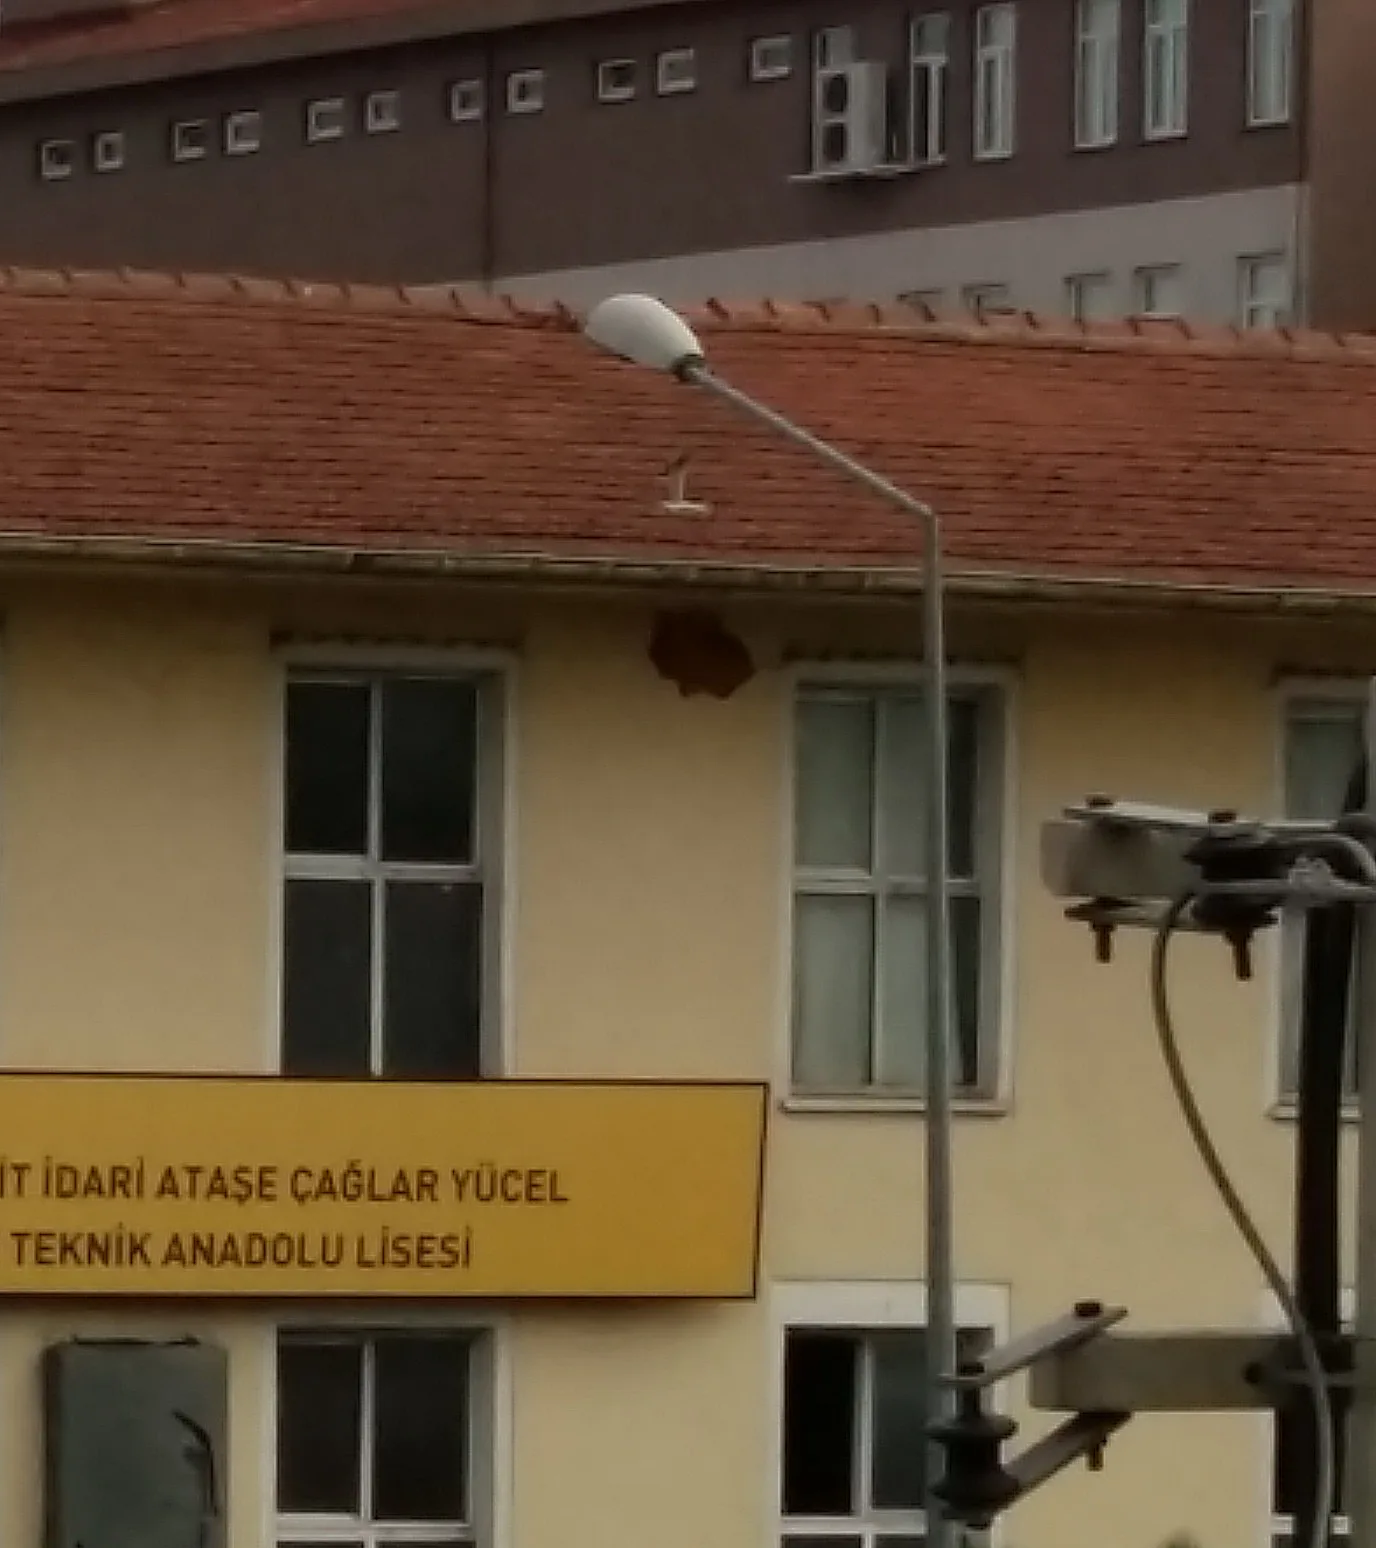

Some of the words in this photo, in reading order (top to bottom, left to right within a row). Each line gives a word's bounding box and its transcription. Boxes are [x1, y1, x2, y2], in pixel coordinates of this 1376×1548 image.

[44, 1156, 144, 1200] İDARİ
[155, 1163, 278, 1206] ATAŞE
[290, 1159, 439, 1206] ÇAĞLAR
[451, 1163, 570, 1203] YÜCEL
[9, 1222, 152, 1268] TEKNİK
[160, 1230, 346, 1268] ANADOLU
[355, 1225, 474, 1269] LİSESİ
